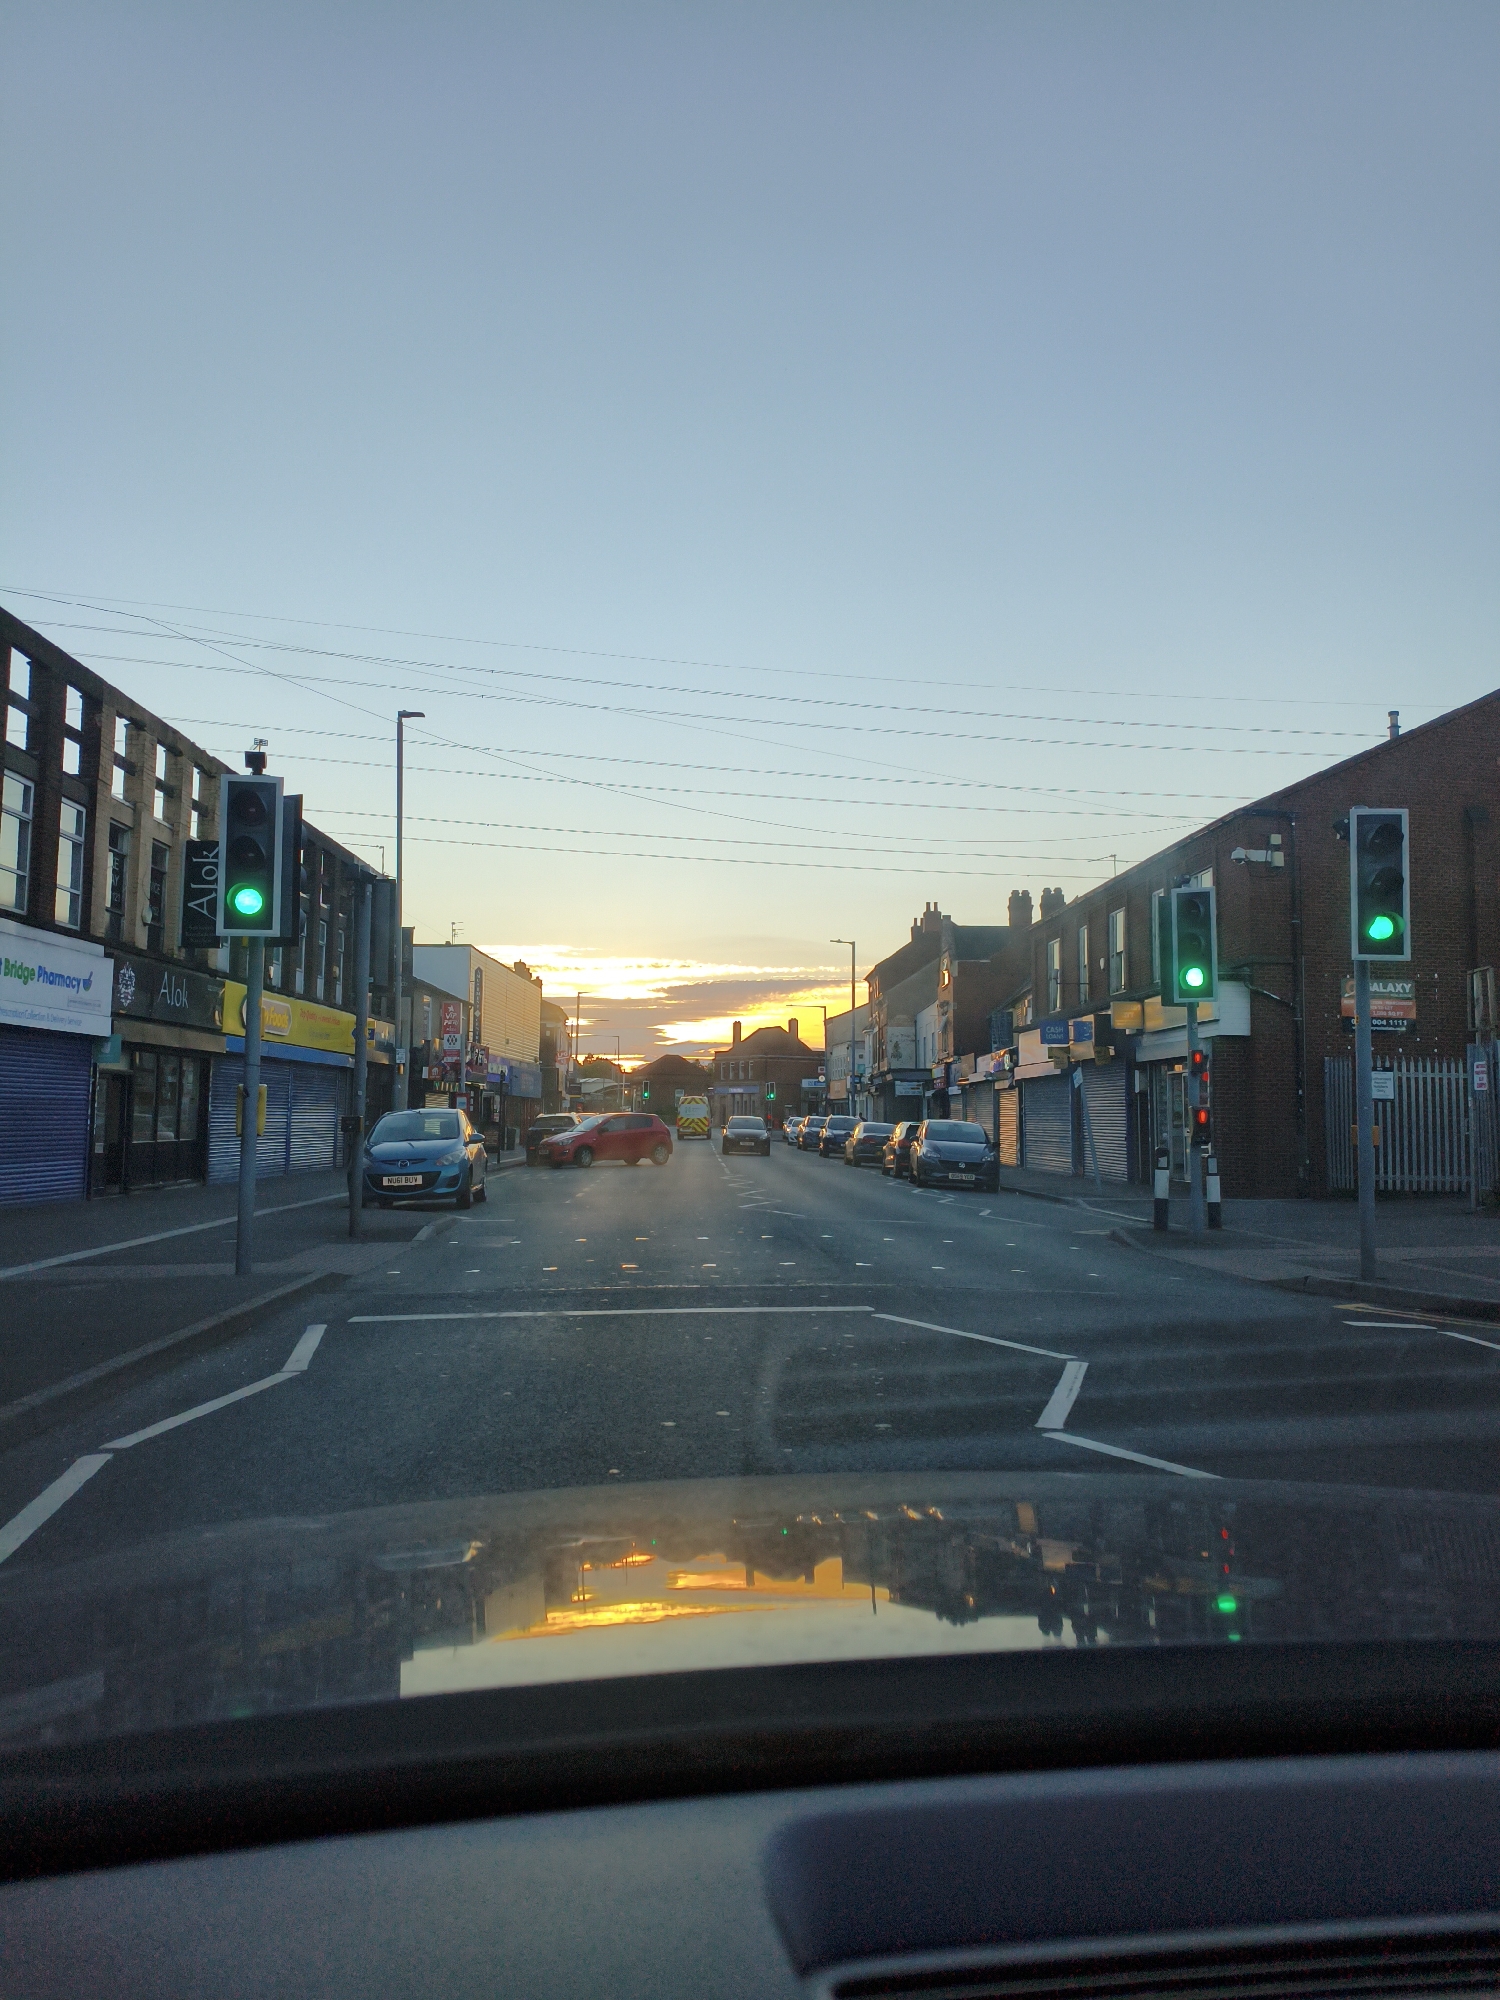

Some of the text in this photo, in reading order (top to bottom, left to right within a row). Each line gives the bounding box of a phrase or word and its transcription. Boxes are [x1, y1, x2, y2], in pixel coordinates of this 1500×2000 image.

[3, 957, 36, 986] Bridge
[37, 965, 82, 994] Pharmacy
[157, 971, 189, 1008] Alok
[387, 1177, 403, 1185] NU61
